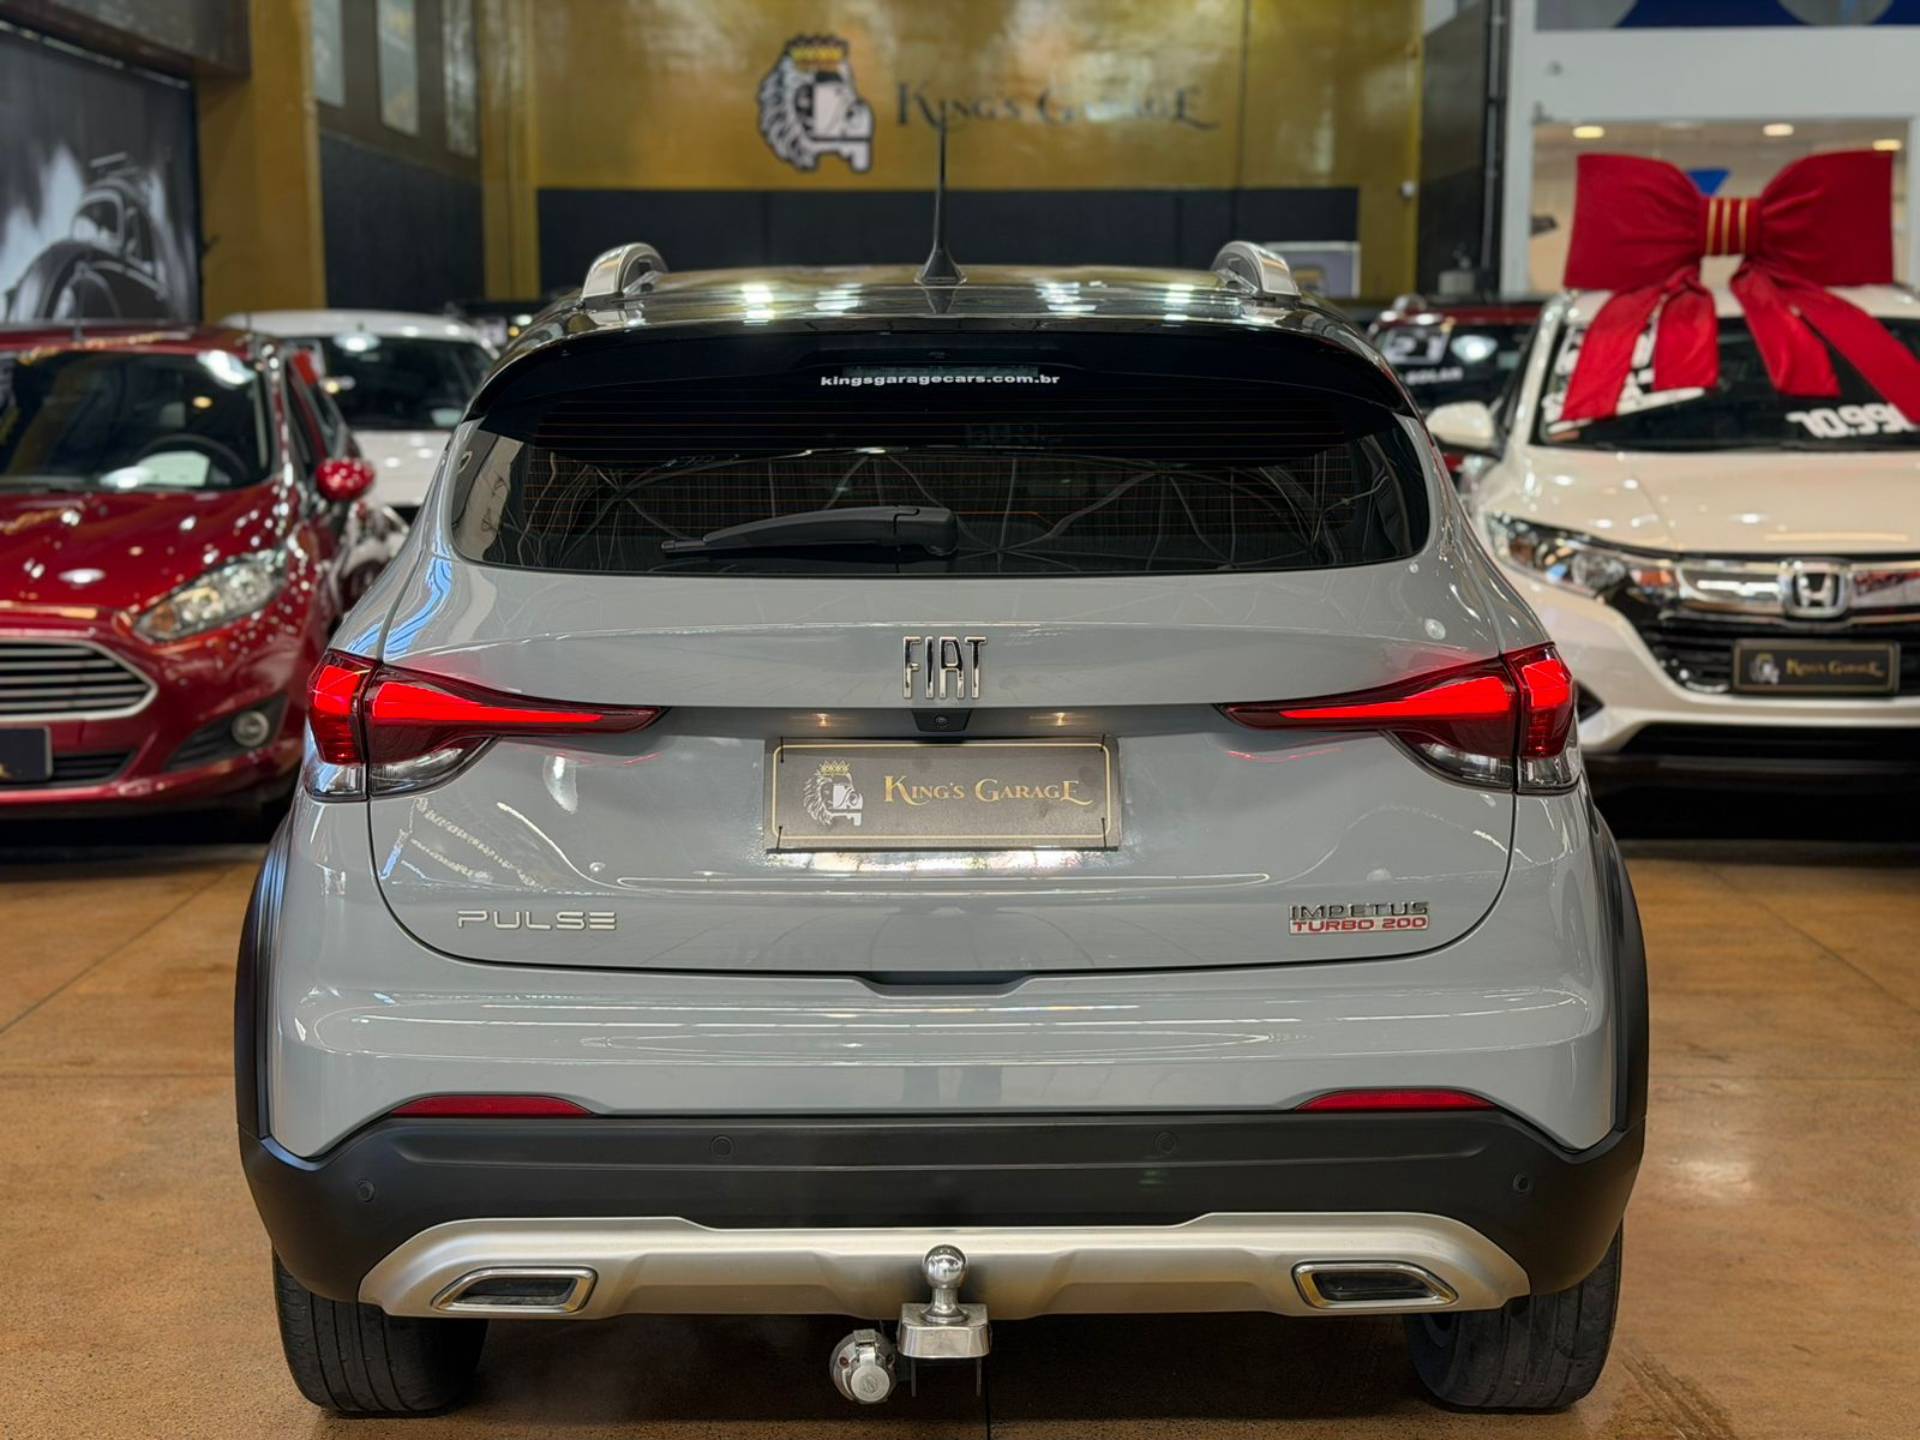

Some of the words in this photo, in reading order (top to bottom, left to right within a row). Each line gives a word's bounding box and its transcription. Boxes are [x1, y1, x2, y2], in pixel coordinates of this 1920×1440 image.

[820, 374, 1060, 387] kingsgaragecars.com.br
[903, 636, 987, 699] FIAT
[457, 910, 616, 930] PULSE
[1289, 902, 1430, 920] IMPETUS
[1292, 918, 1375, 932] TURBO
[1382, 917, 1428, 929] 200
